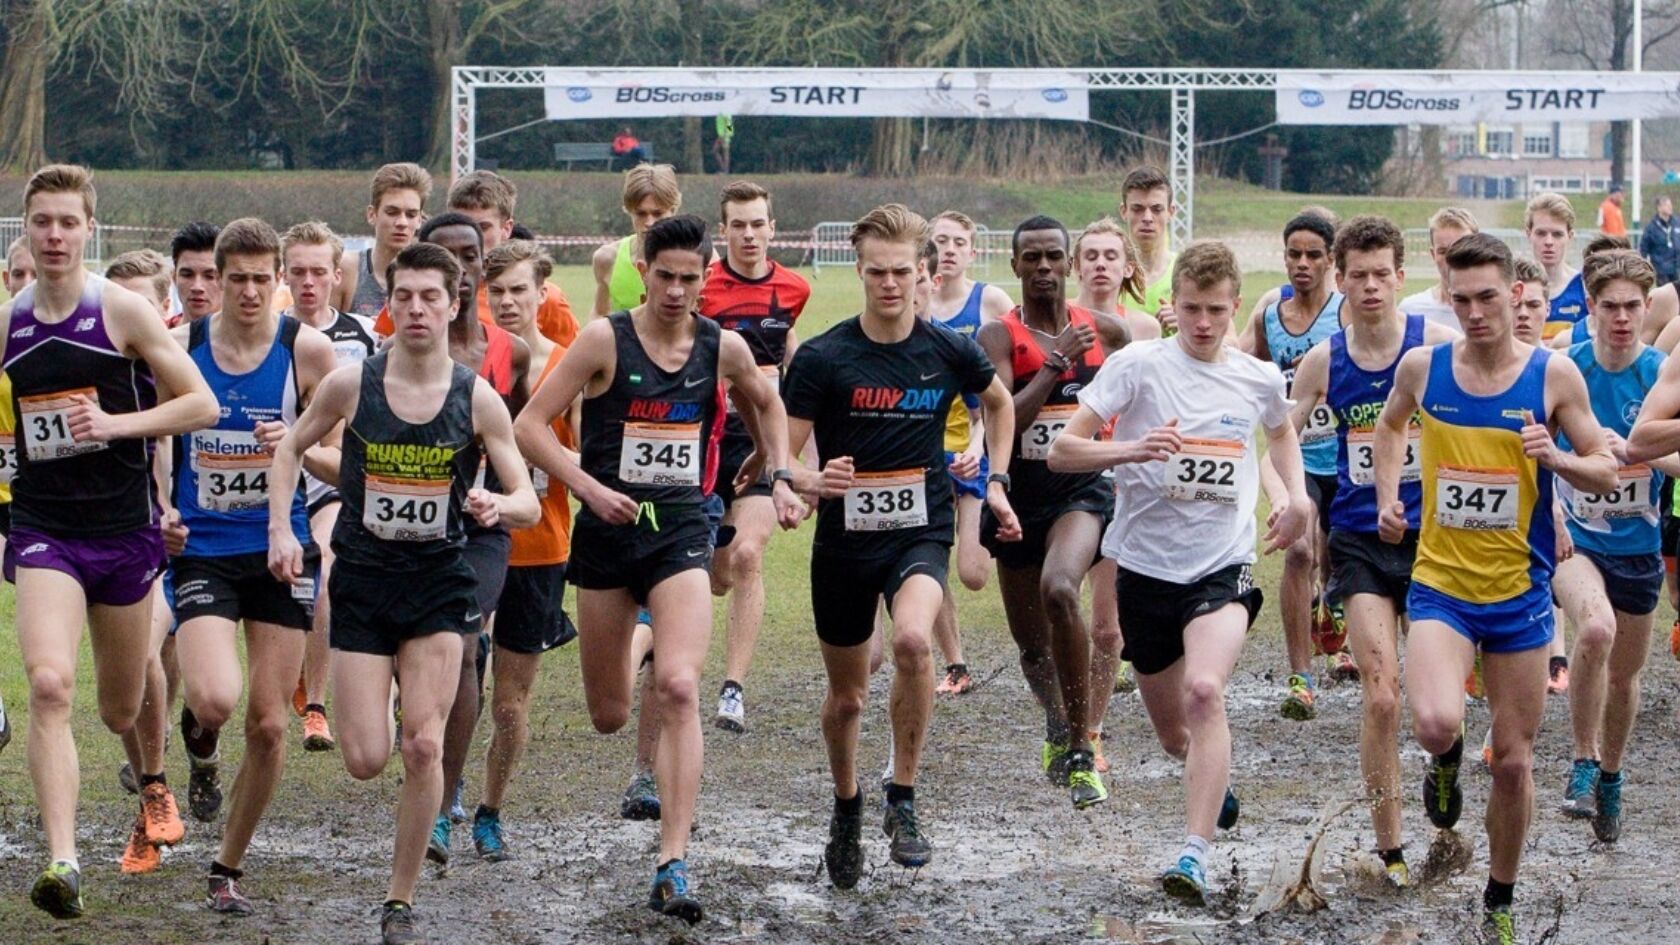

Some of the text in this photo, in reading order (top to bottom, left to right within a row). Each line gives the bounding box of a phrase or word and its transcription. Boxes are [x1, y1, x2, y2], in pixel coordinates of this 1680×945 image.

[615, 86, 867, 105] BOScross START
[1347, 89, 1460, 111] BOScross
[1505, 89, 1606, 110] START
[366, 444, 455, 464] RUNSHOP
[634, 442, 692, 468] 345
[209, 472, 269, 496] 344
[1177, 458, 1235, 486] 322
[376, 497, 437, 525] 340
[856, 488, 914, 515] 338
[1445, 484, 1508, 513] 347
